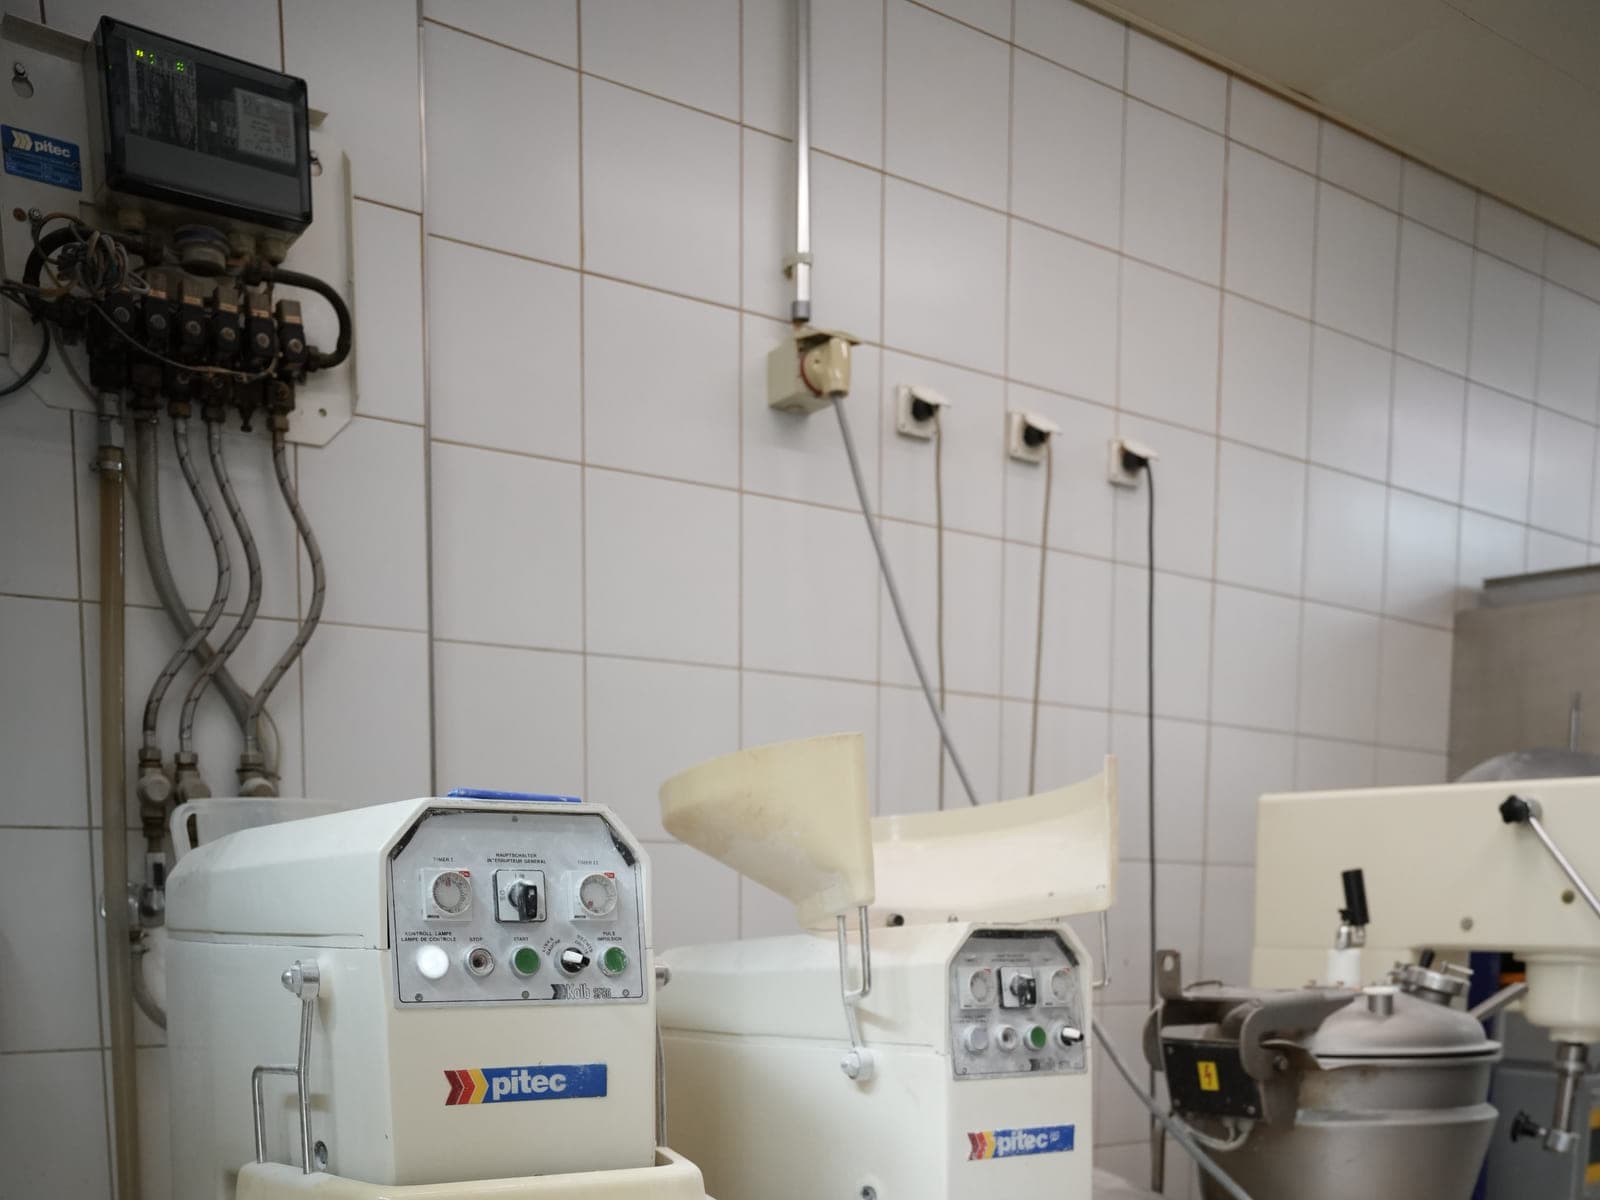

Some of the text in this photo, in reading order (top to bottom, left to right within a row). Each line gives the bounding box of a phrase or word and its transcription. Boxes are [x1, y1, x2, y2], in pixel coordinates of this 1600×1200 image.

[34, 140, 71, 157] pitec
[566, 983, 590, 999] Kolb
[492, 1069, 567, 1101] pitec
[997, 1131, 1049, 1156] pitec
